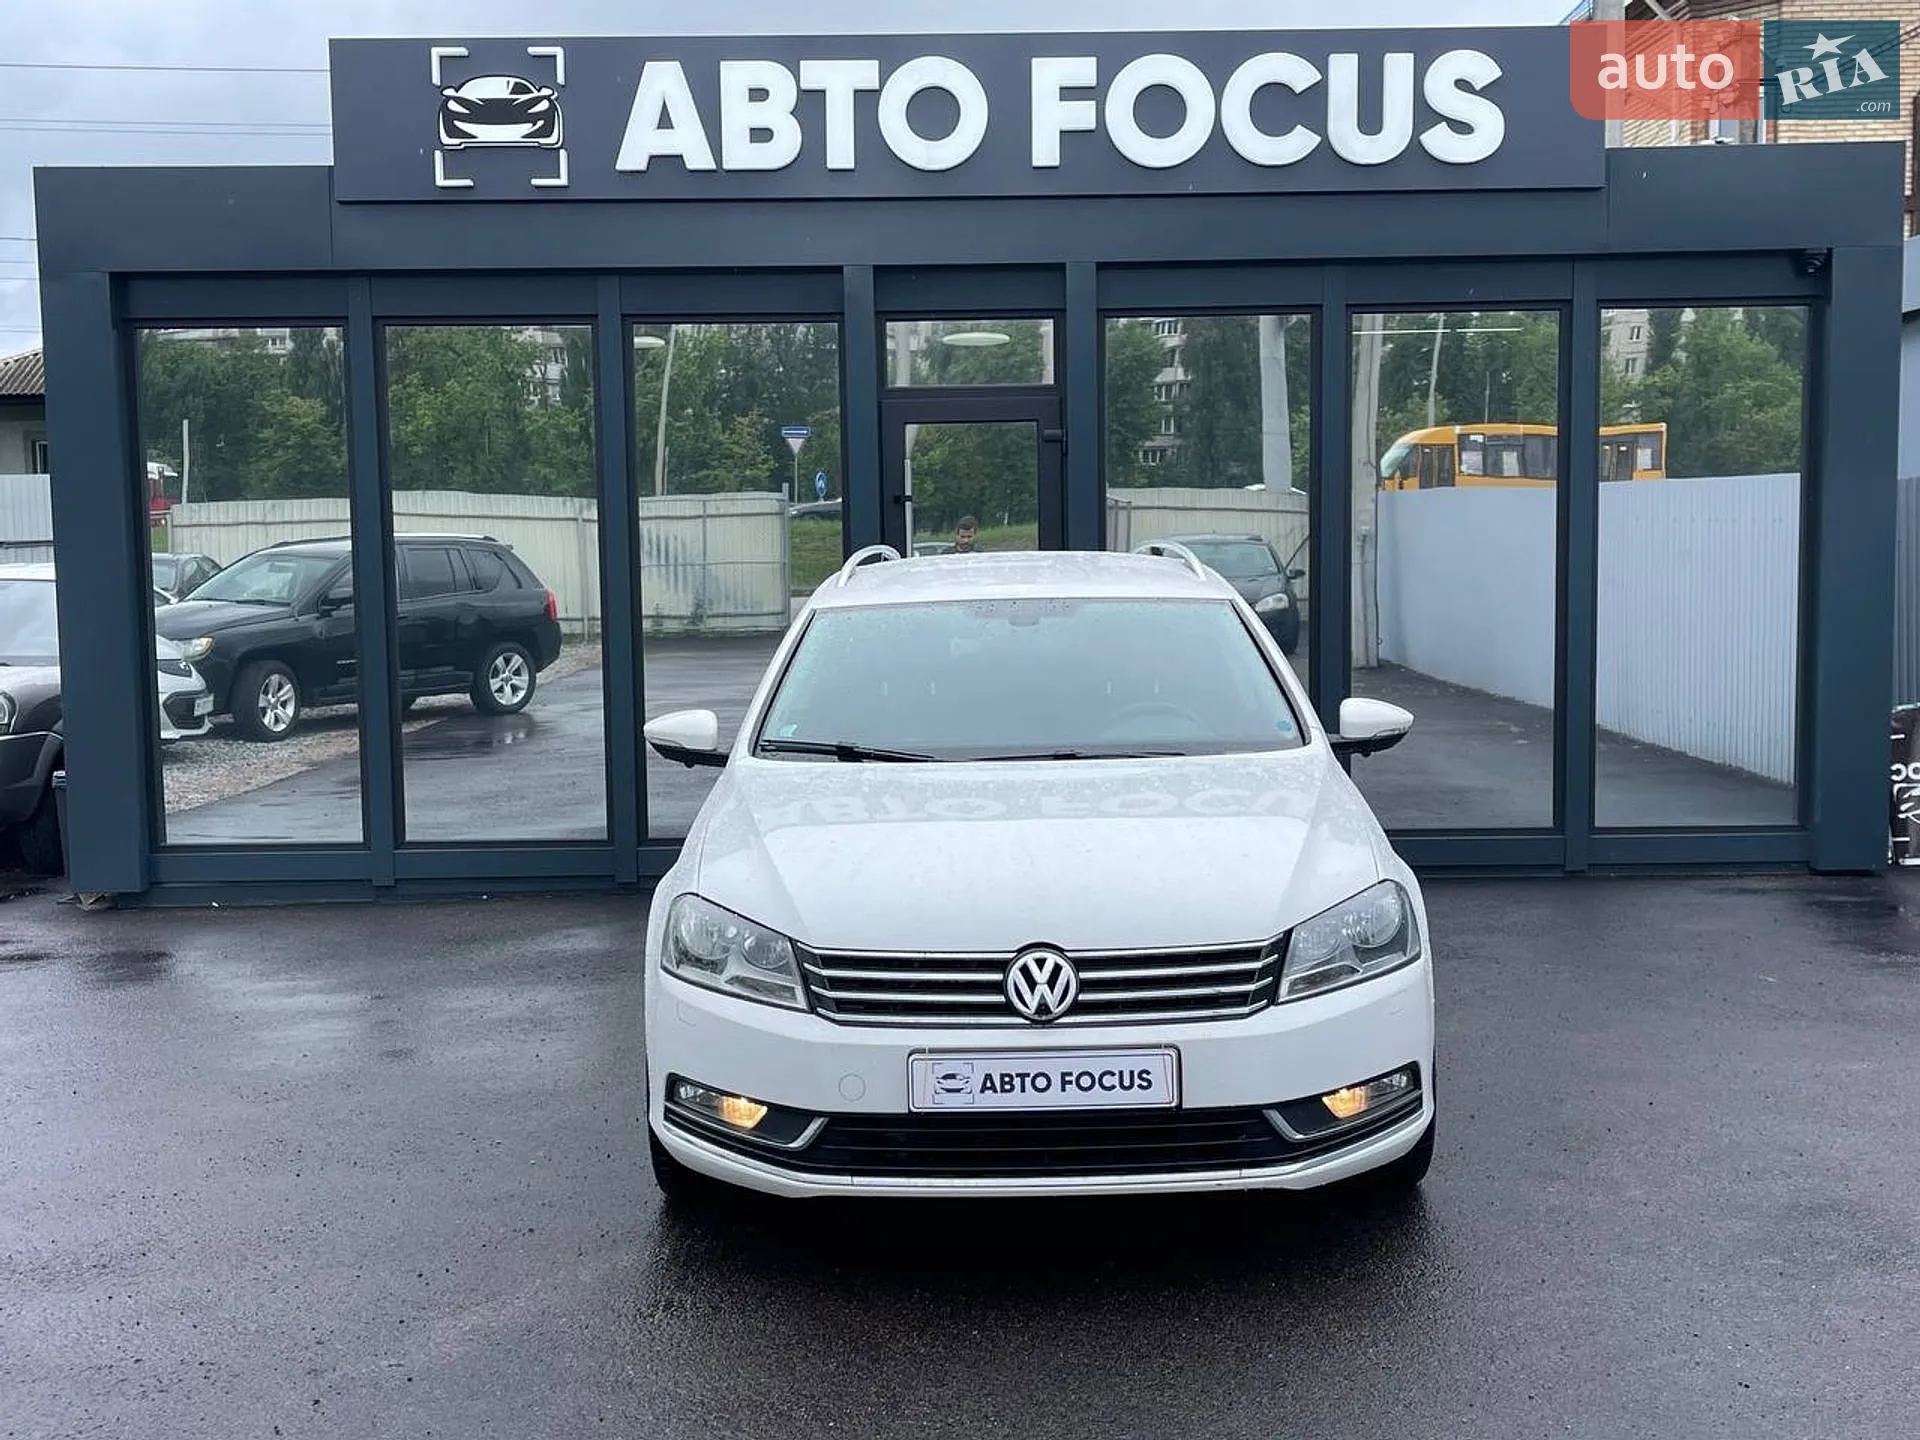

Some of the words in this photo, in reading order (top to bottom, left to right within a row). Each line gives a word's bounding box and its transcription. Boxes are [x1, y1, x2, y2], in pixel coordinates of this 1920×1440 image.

[615, 55, 989, 171] АВТО
[1031, 49, 1506, 168] FOCUS
[979, 1071, 1052, 1094] АВТО
[1060, 1069, 1153, 1093] FOCUS
